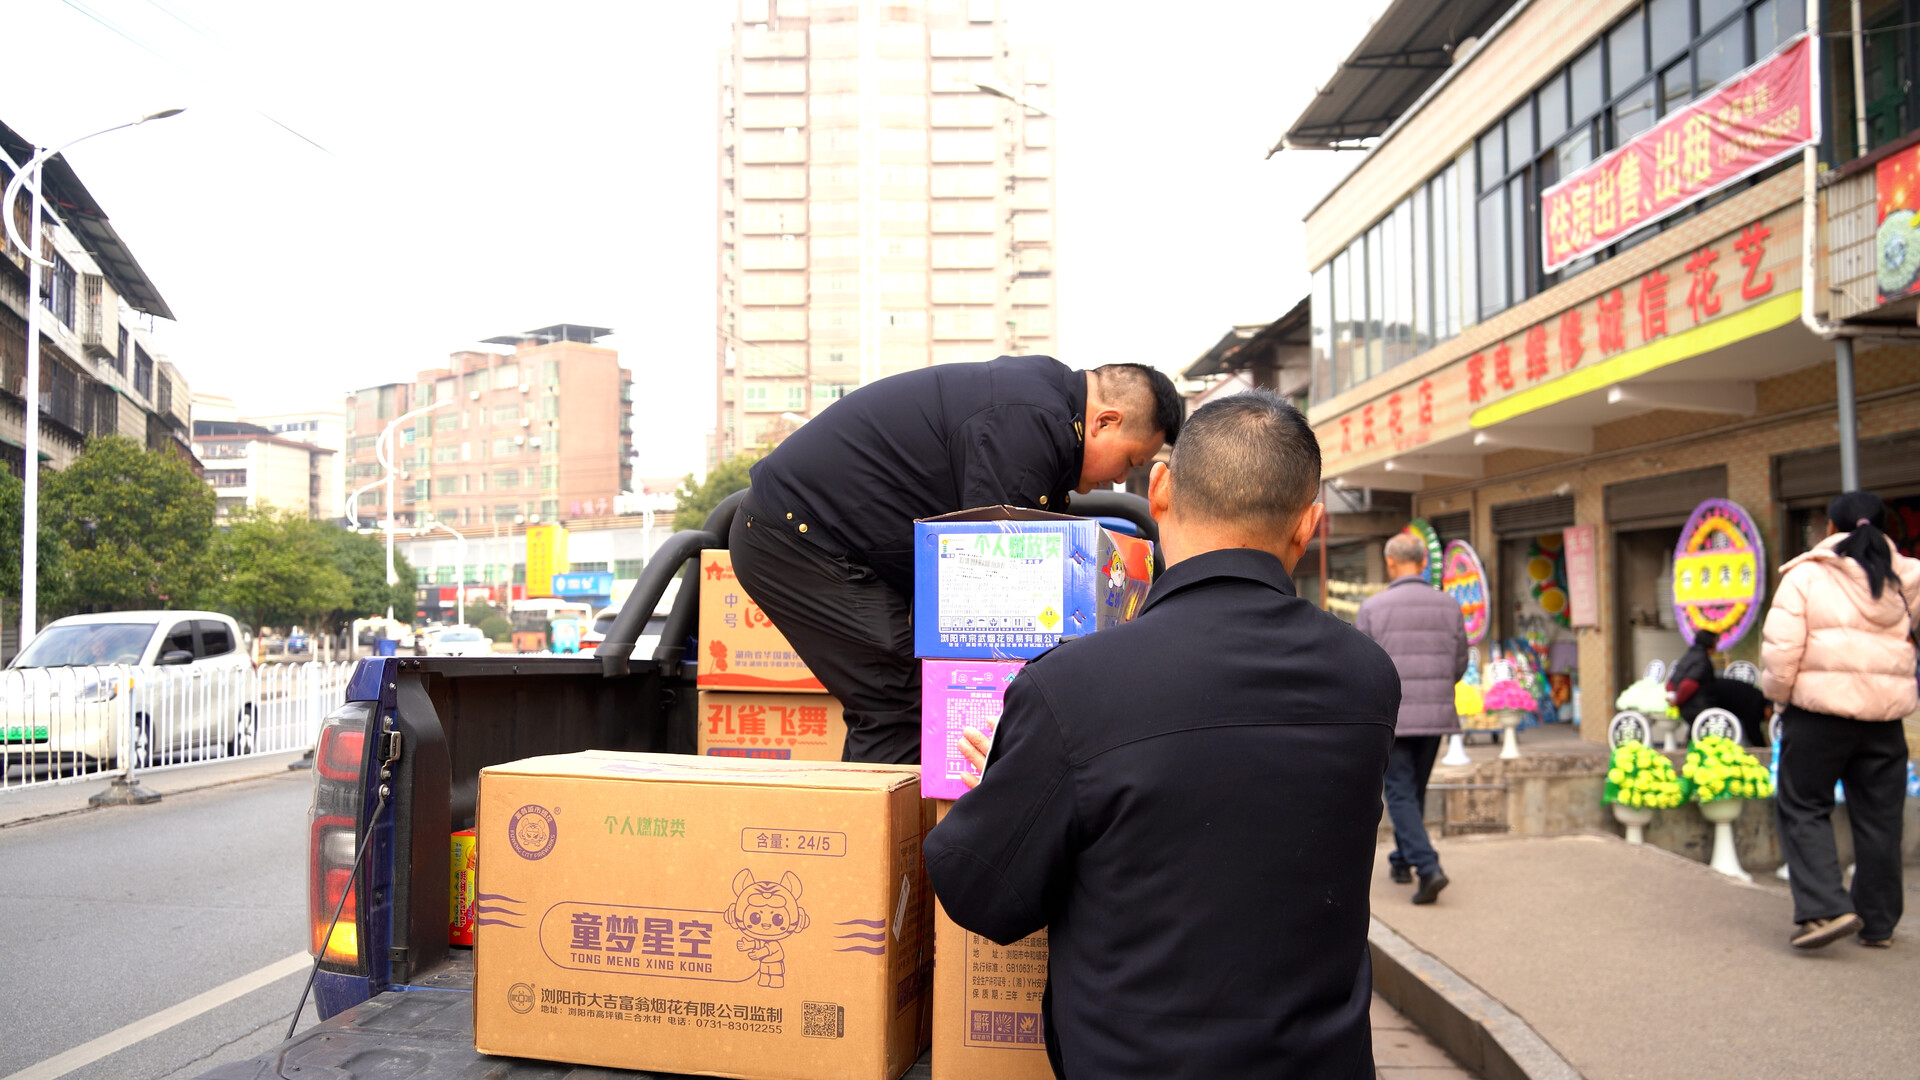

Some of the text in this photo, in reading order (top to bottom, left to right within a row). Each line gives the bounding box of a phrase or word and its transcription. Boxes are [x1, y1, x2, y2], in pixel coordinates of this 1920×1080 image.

[1548, 113, 1713, 258] 住房出售、出租
[1466, 222, 1776, 403] 家电维修诚信花艺
[974, 534, 1062, 559] 个人燃放类
[723, 593, 738, 628] 中号
[707, 704, 828, 737] 孔雀飞舞
[603, 815, 686, 839] 个人燃放类
[570, 912, 713, 960] 童梦星空
[570, 952, 712, 974] TONG MENG XING KONG
[540, 988, 783, 1024] 浏阳市大吉富翁烟花有限公司监制
